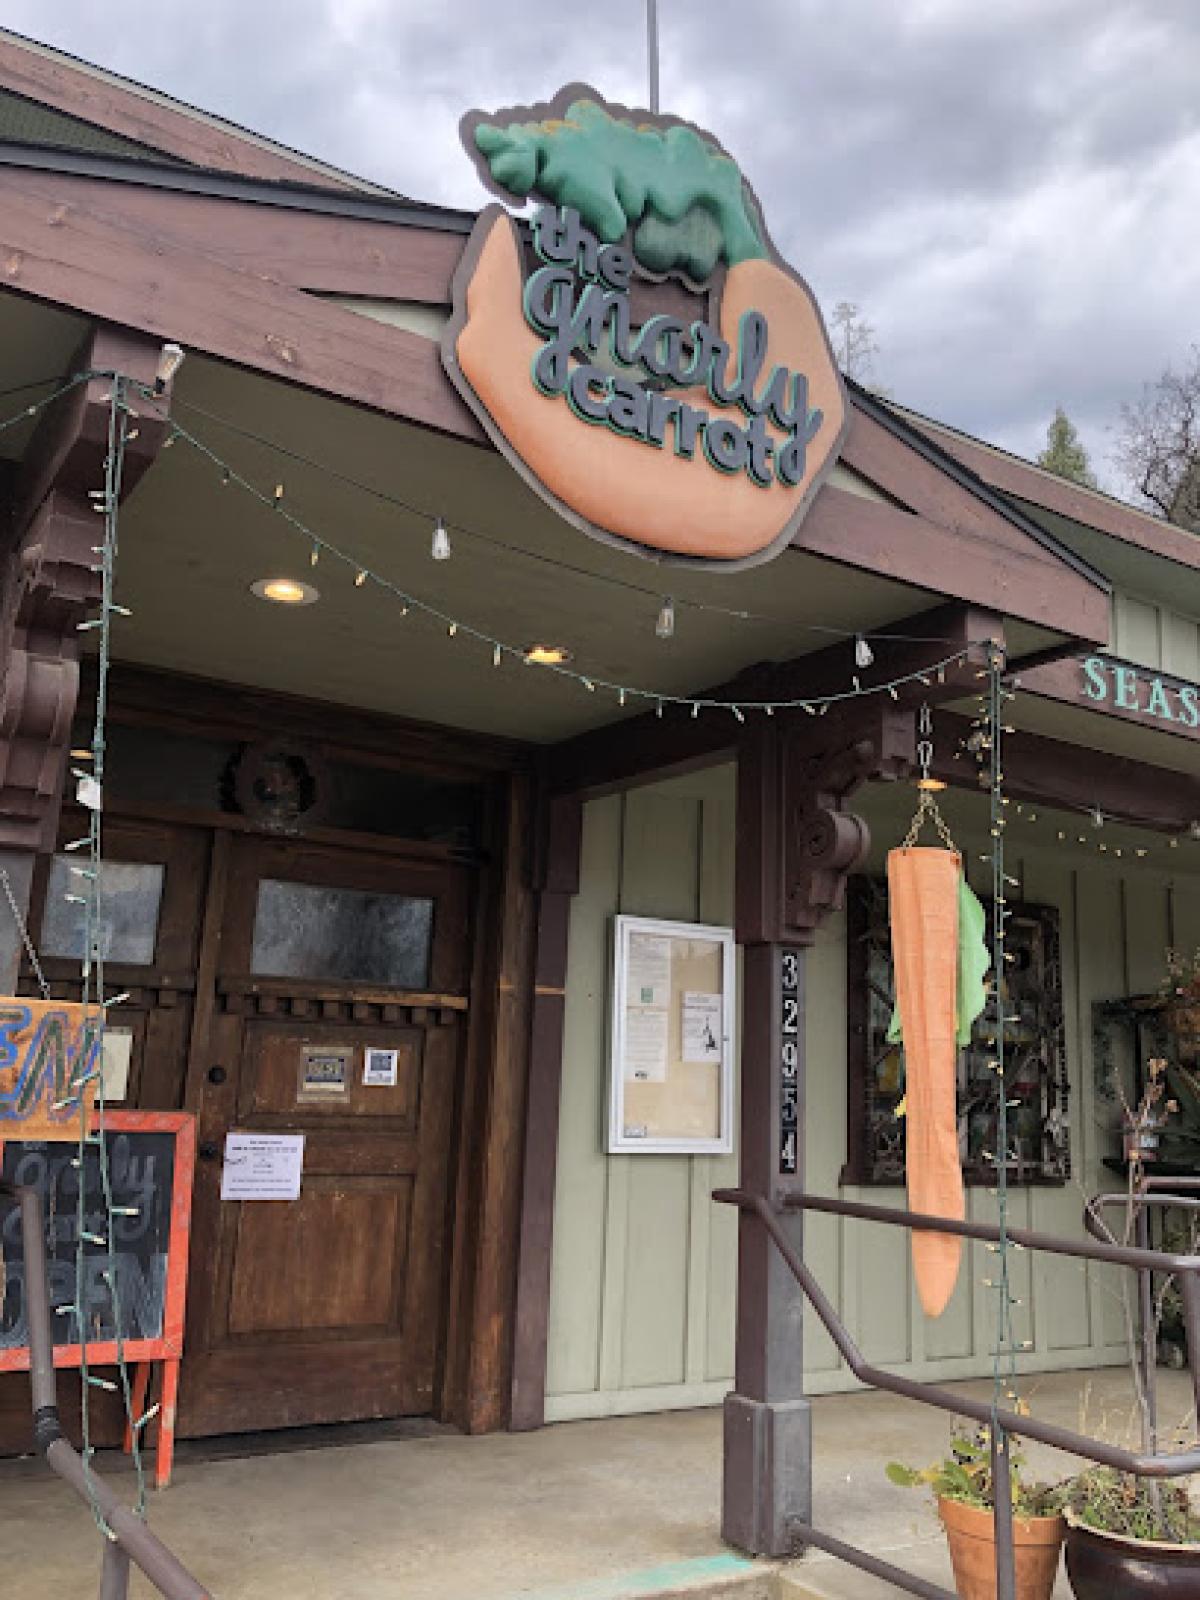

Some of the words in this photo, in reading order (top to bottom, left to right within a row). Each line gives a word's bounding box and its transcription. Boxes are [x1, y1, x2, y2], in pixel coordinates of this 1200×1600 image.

[530, 206, 632, 291] the
[523, 266, 823, 488] gnarly
[567, 364, 776, 488] carrot
[1080, 657, 1199, 728] SEAS
